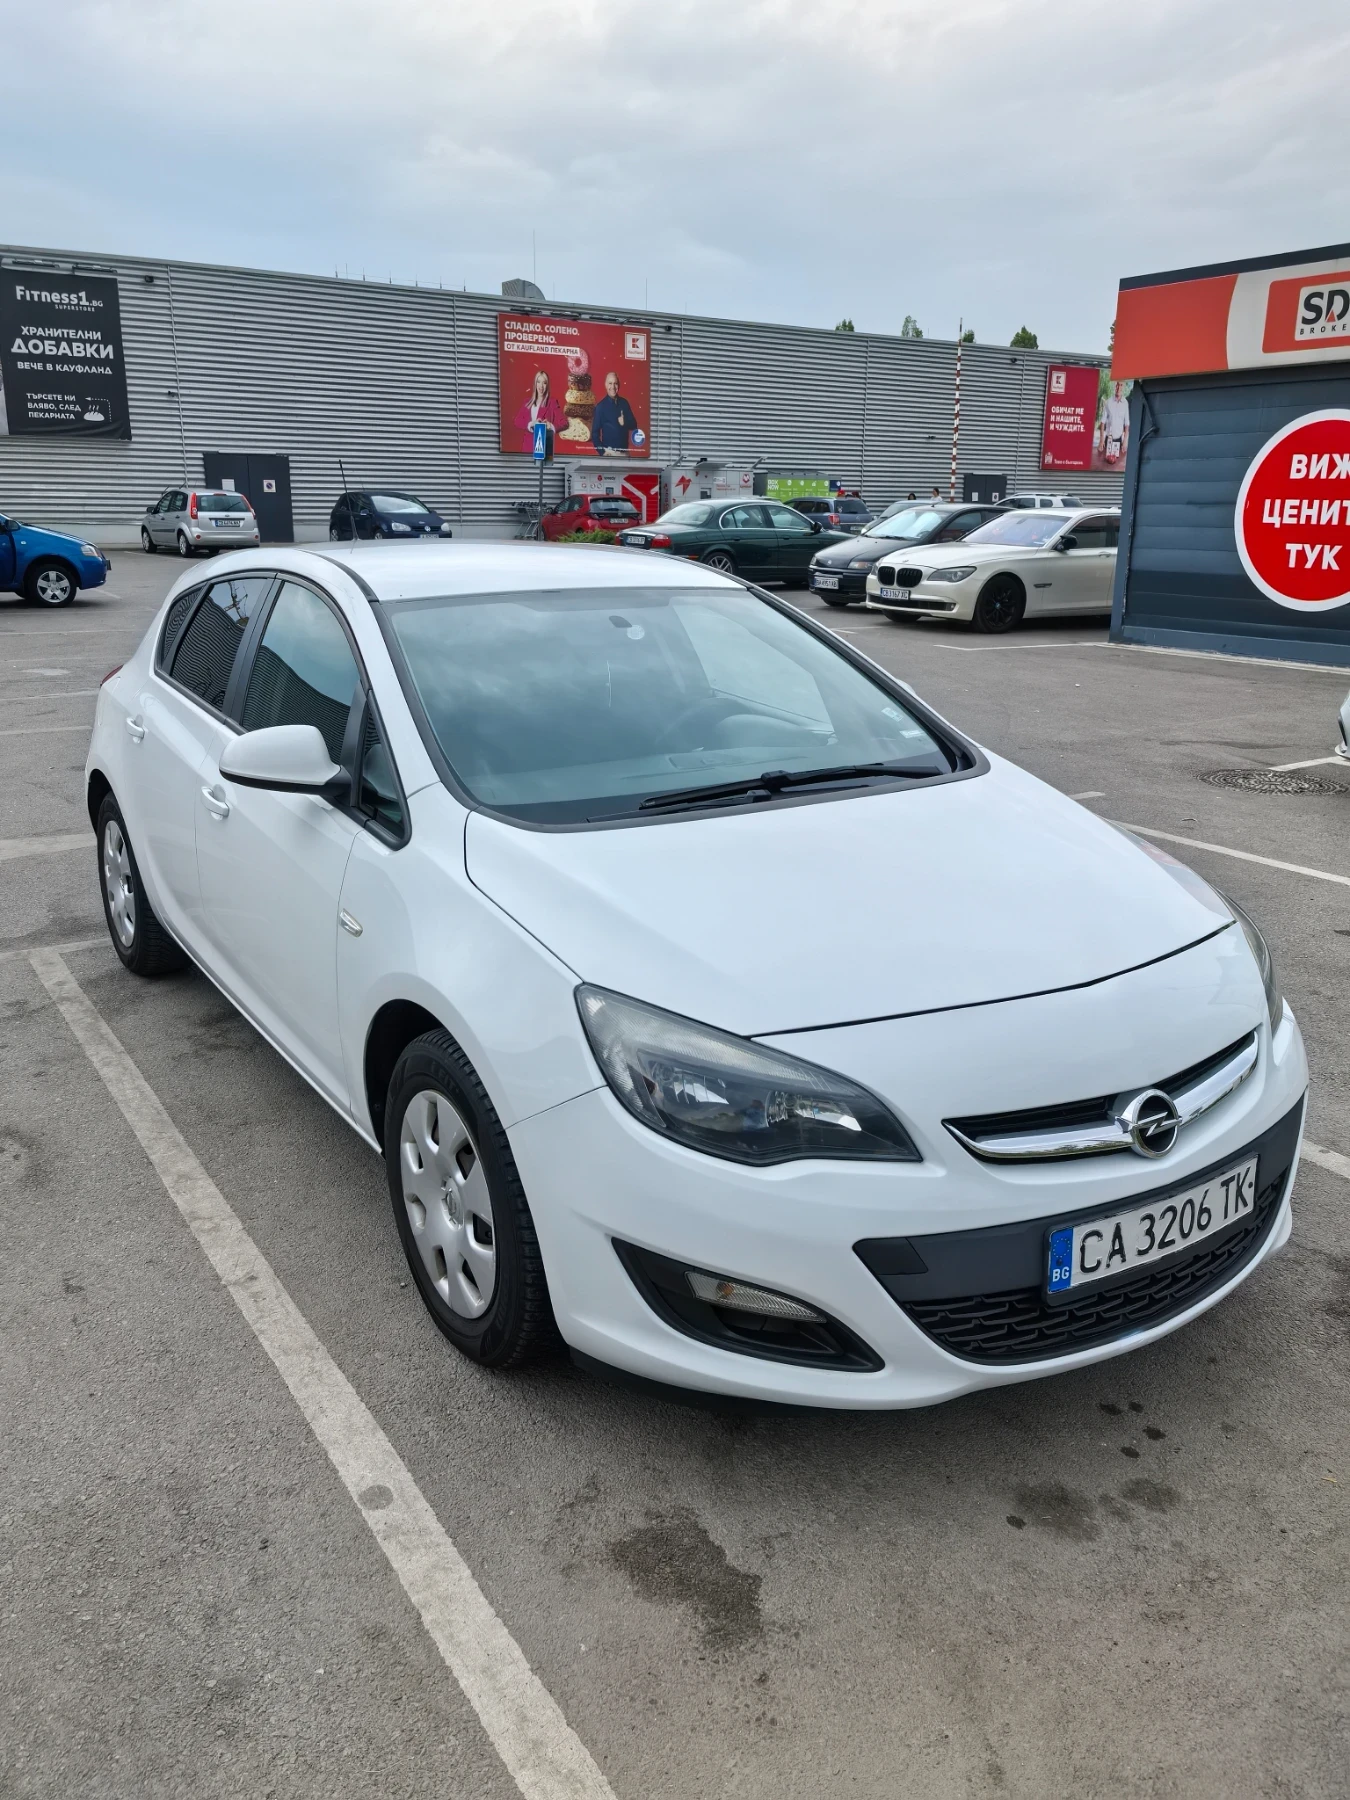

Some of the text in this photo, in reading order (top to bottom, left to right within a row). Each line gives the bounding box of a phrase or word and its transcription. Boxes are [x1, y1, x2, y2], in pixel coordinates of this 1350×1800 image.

[54, 304, 96, 312] SUPERSTORE
[20, 325, 102, 340] ХРАНИТЕЛНИ
[504, 321, 580, 336] СЛАДКО. СОЛЕНО.
[504, 331, 557, 344] ПРОВЕРЕНО.
[10, 337, 114, 359] ДОБАВКИ
[516, 344, 549, 353] KAUFLAND
[550, 347, 579, 355] ПЕКАРНА
[17, 361, 113, 375] ВЕЧЕ В КАУФЛАНД
[26, 392, 62, 401] ТЪРСЕТЕ
[27, 402, 81, 412] ВЛЯВО, СЛЕД
[1051, 406, 1074, 414] ОБИЧАТ
[28, 411, 75, 420] ПЕКАРНАТА
[1055, 424, 1085, 432] ЧУЖДИТЕ.
[1289, 453, 1350, 479] ВИЖ
[1285, 543, 1343, 570] ТУК
[1079, 1166, 1251, 1274] CA 3206 TK
[1052, 1266, 1070, 1282] BG
